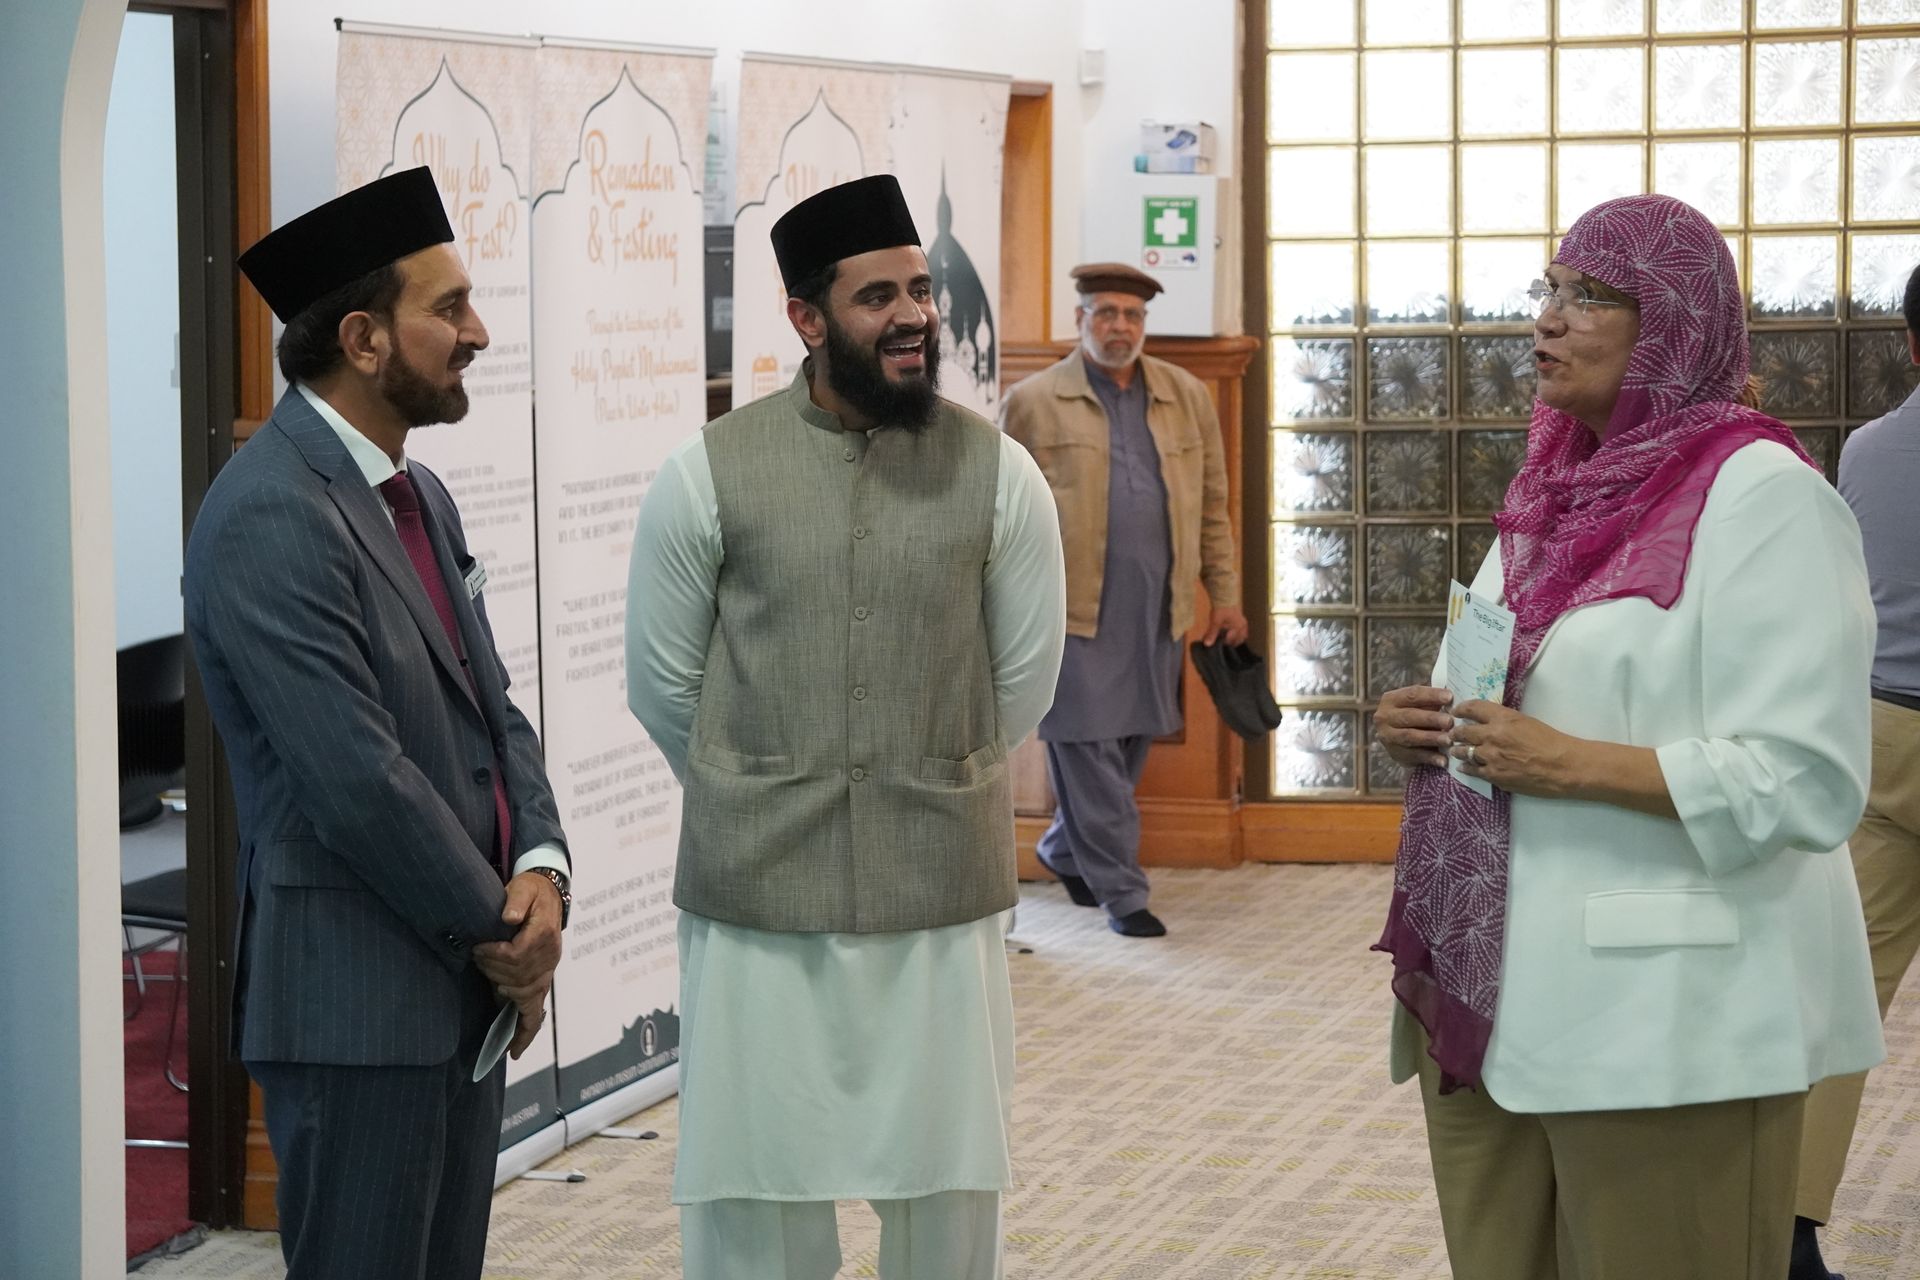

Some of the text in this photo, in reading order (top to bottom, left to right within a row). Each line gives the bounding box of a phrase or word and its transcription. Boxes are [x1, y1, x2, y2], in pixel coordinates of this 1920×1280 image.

[469, 138, 490, 192] do
[585, 130, 675, 206] Ramadan
[462, 201, 517, 270] Fast?
[609, 200, 678, 287] Fasting
[637, 344, 698, 386] Muhammad
